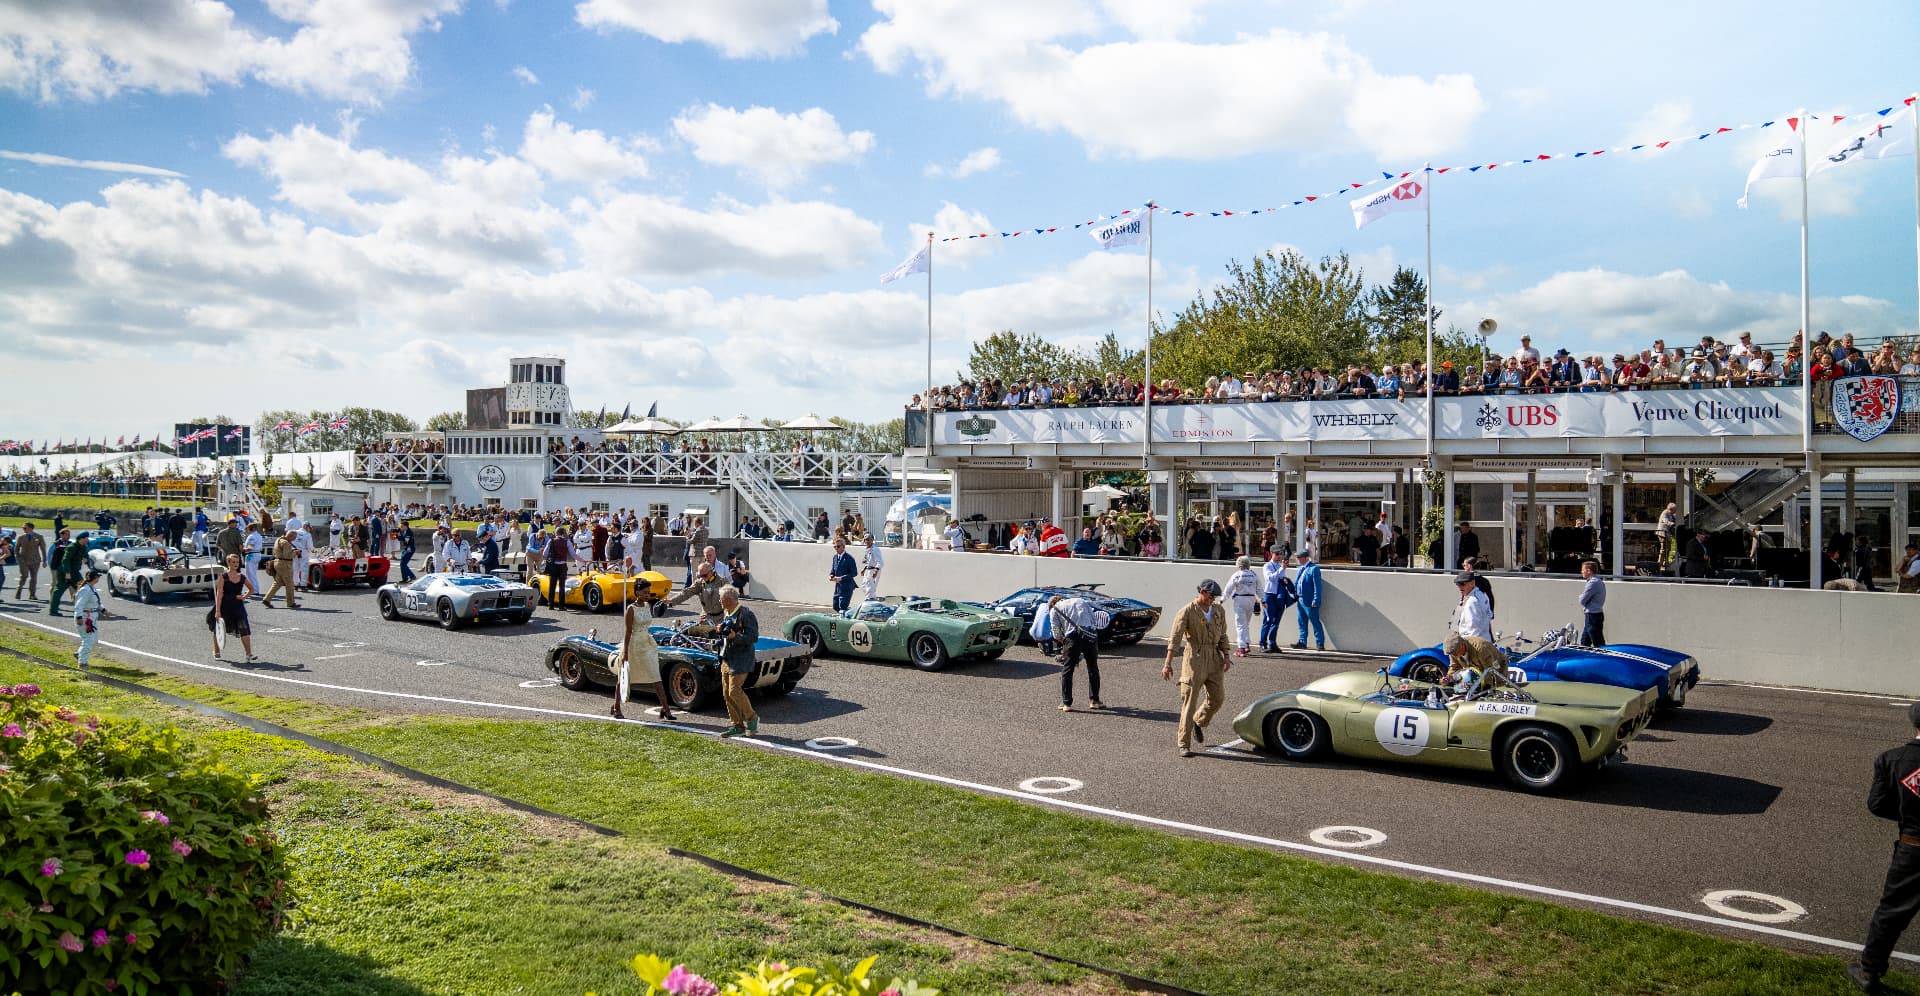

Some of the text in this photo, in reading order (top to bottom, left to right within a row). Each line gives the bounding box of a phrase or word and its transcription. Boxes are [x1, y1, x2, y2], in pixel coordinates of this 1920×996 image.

[1506, 404, 1557, 426] UBS
[1632, 400, 1783, 424] Veuve Clicquot
[1048, 420, 1133, 431] RALPH LAUREN
[1172, 429, 1233, 438] EDMISTON
[1028, 458, 1033, 467] 2
[1276, 458, 1281, 468] 4
[407, 594, 418, 611] 23
[851, 630, 869, 647] 194
[1501, 704, 1530, 714] DIBLEY
[1393, 714, 1419, 740] 15
